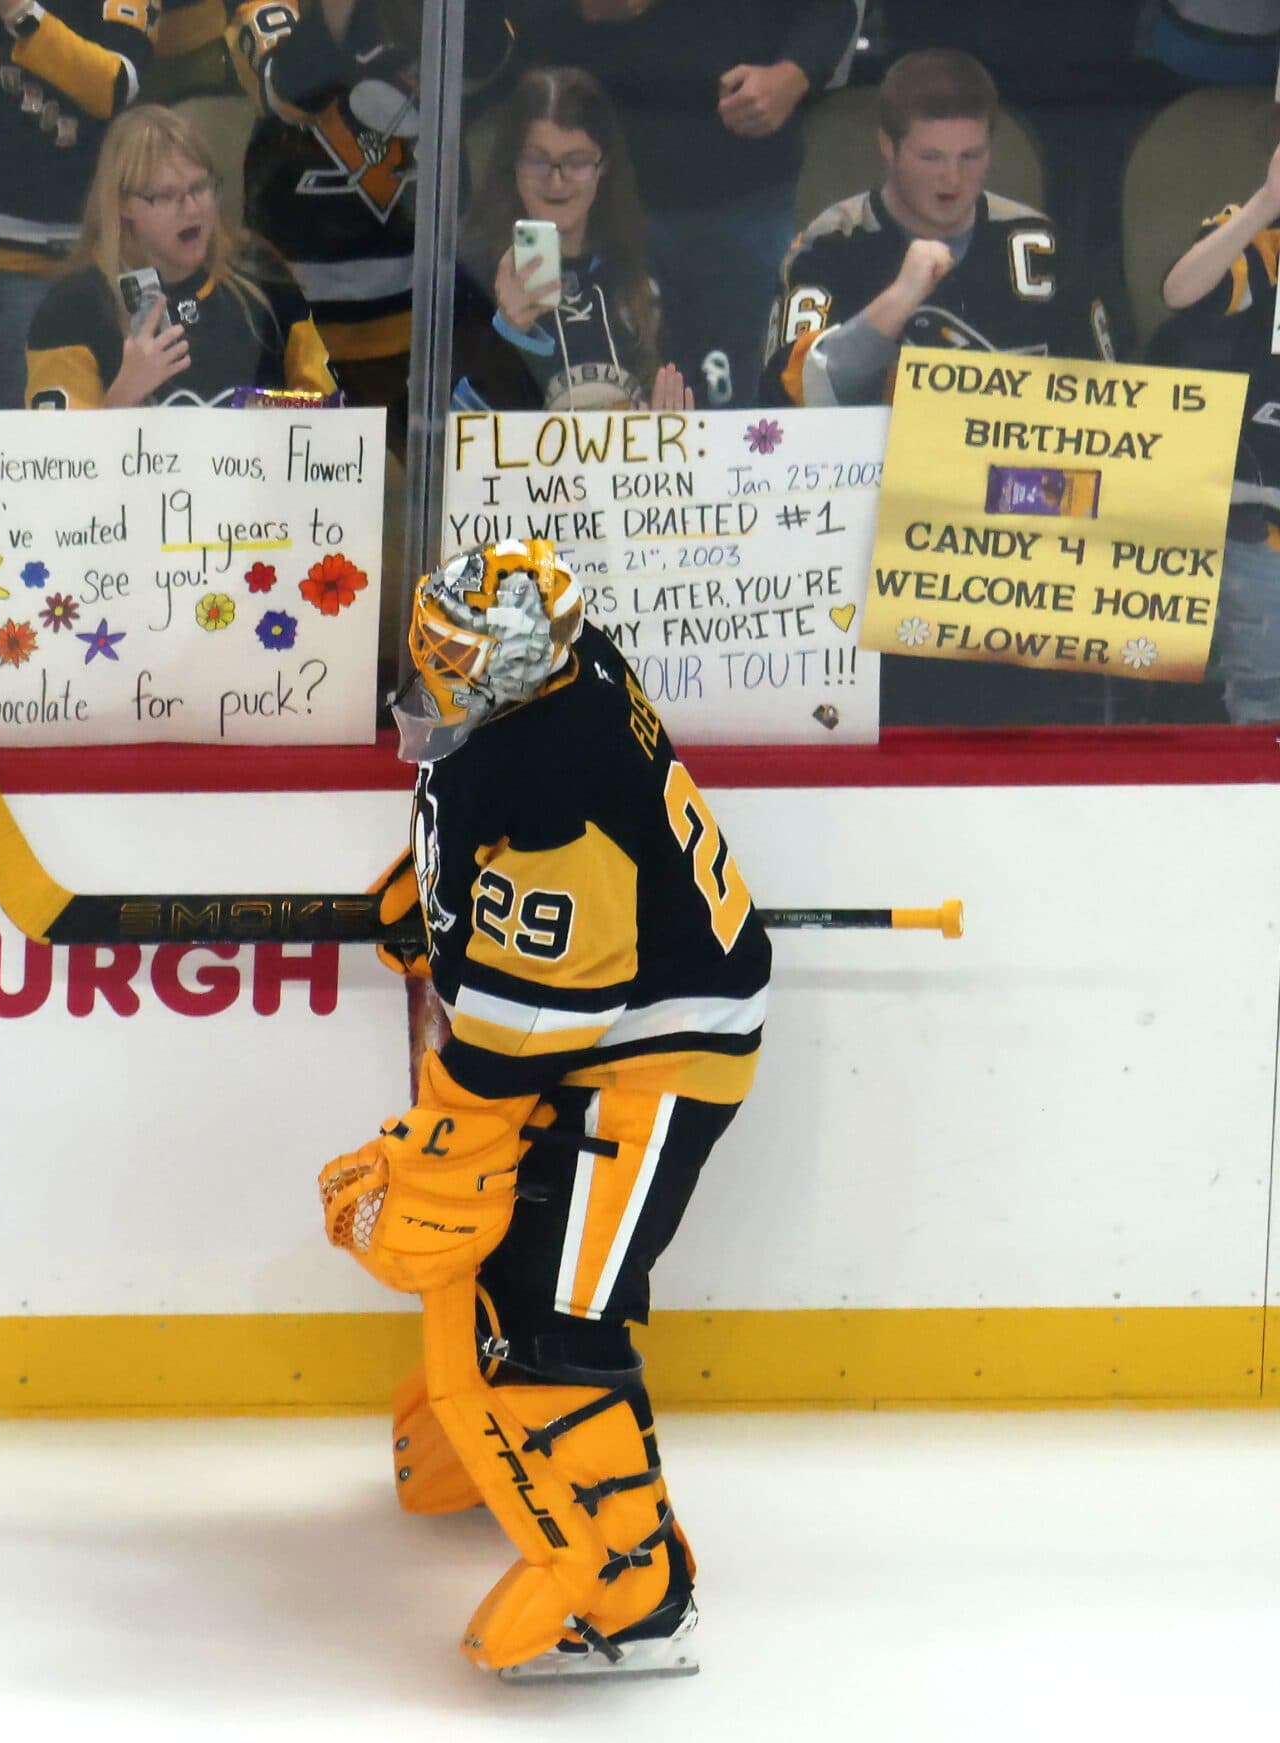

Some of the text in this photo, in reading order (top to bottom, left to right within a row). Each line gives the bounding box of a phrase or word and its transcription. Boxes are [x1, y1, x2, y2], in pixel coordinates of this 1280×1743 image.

[1008, 229, 1055, 299] C
[906, 361, 1206, 412] TODAY IS MY 15
[121, 427, 182, 476] chez
[211, 454, 267, 483] vous,
[287, 425, 364, 484] Flower!
[456, 414, 706, 471] FLOWER:
[964, 418, 1162, 460] BIRTHDAY
[482, 475, 501, 506] I
[526, 475, 587, 504] WAS
[612, 472, 694, 500] BORN
[727, 466, 770, 497] Jan
[55, 505, 127, 545] waited
[161, 490, 192, 545] 19
[216, 518, 290, 574] years
[310, 508, 344, 546] to
[450, 501, 846, 545] YOU WERE DRAFTED #1
[904, 522, 1218, 577] CANDY 4 PUCK
[678, 544, 741, 568] 2003
[148, 547, 210, 632] you!
[735, 566, 843, 604] YOU'RE
[875, 569, 1211, 626] WELCOME HOME
[603, 604, 815, 648] MY FAVORITE
[936, 624, 1110, 663] FLOWER
[131, 669, 184, 720] for
[219, 659, 328, 737] puck?
[664, 759, 752, 955] 2
[120, 900, 373, 936] SMOKE
[475, 867, 575, 962] 29
[400, 1215, 478, 1233] TRUE
[484, 1411, 569, 1549] TRUE
